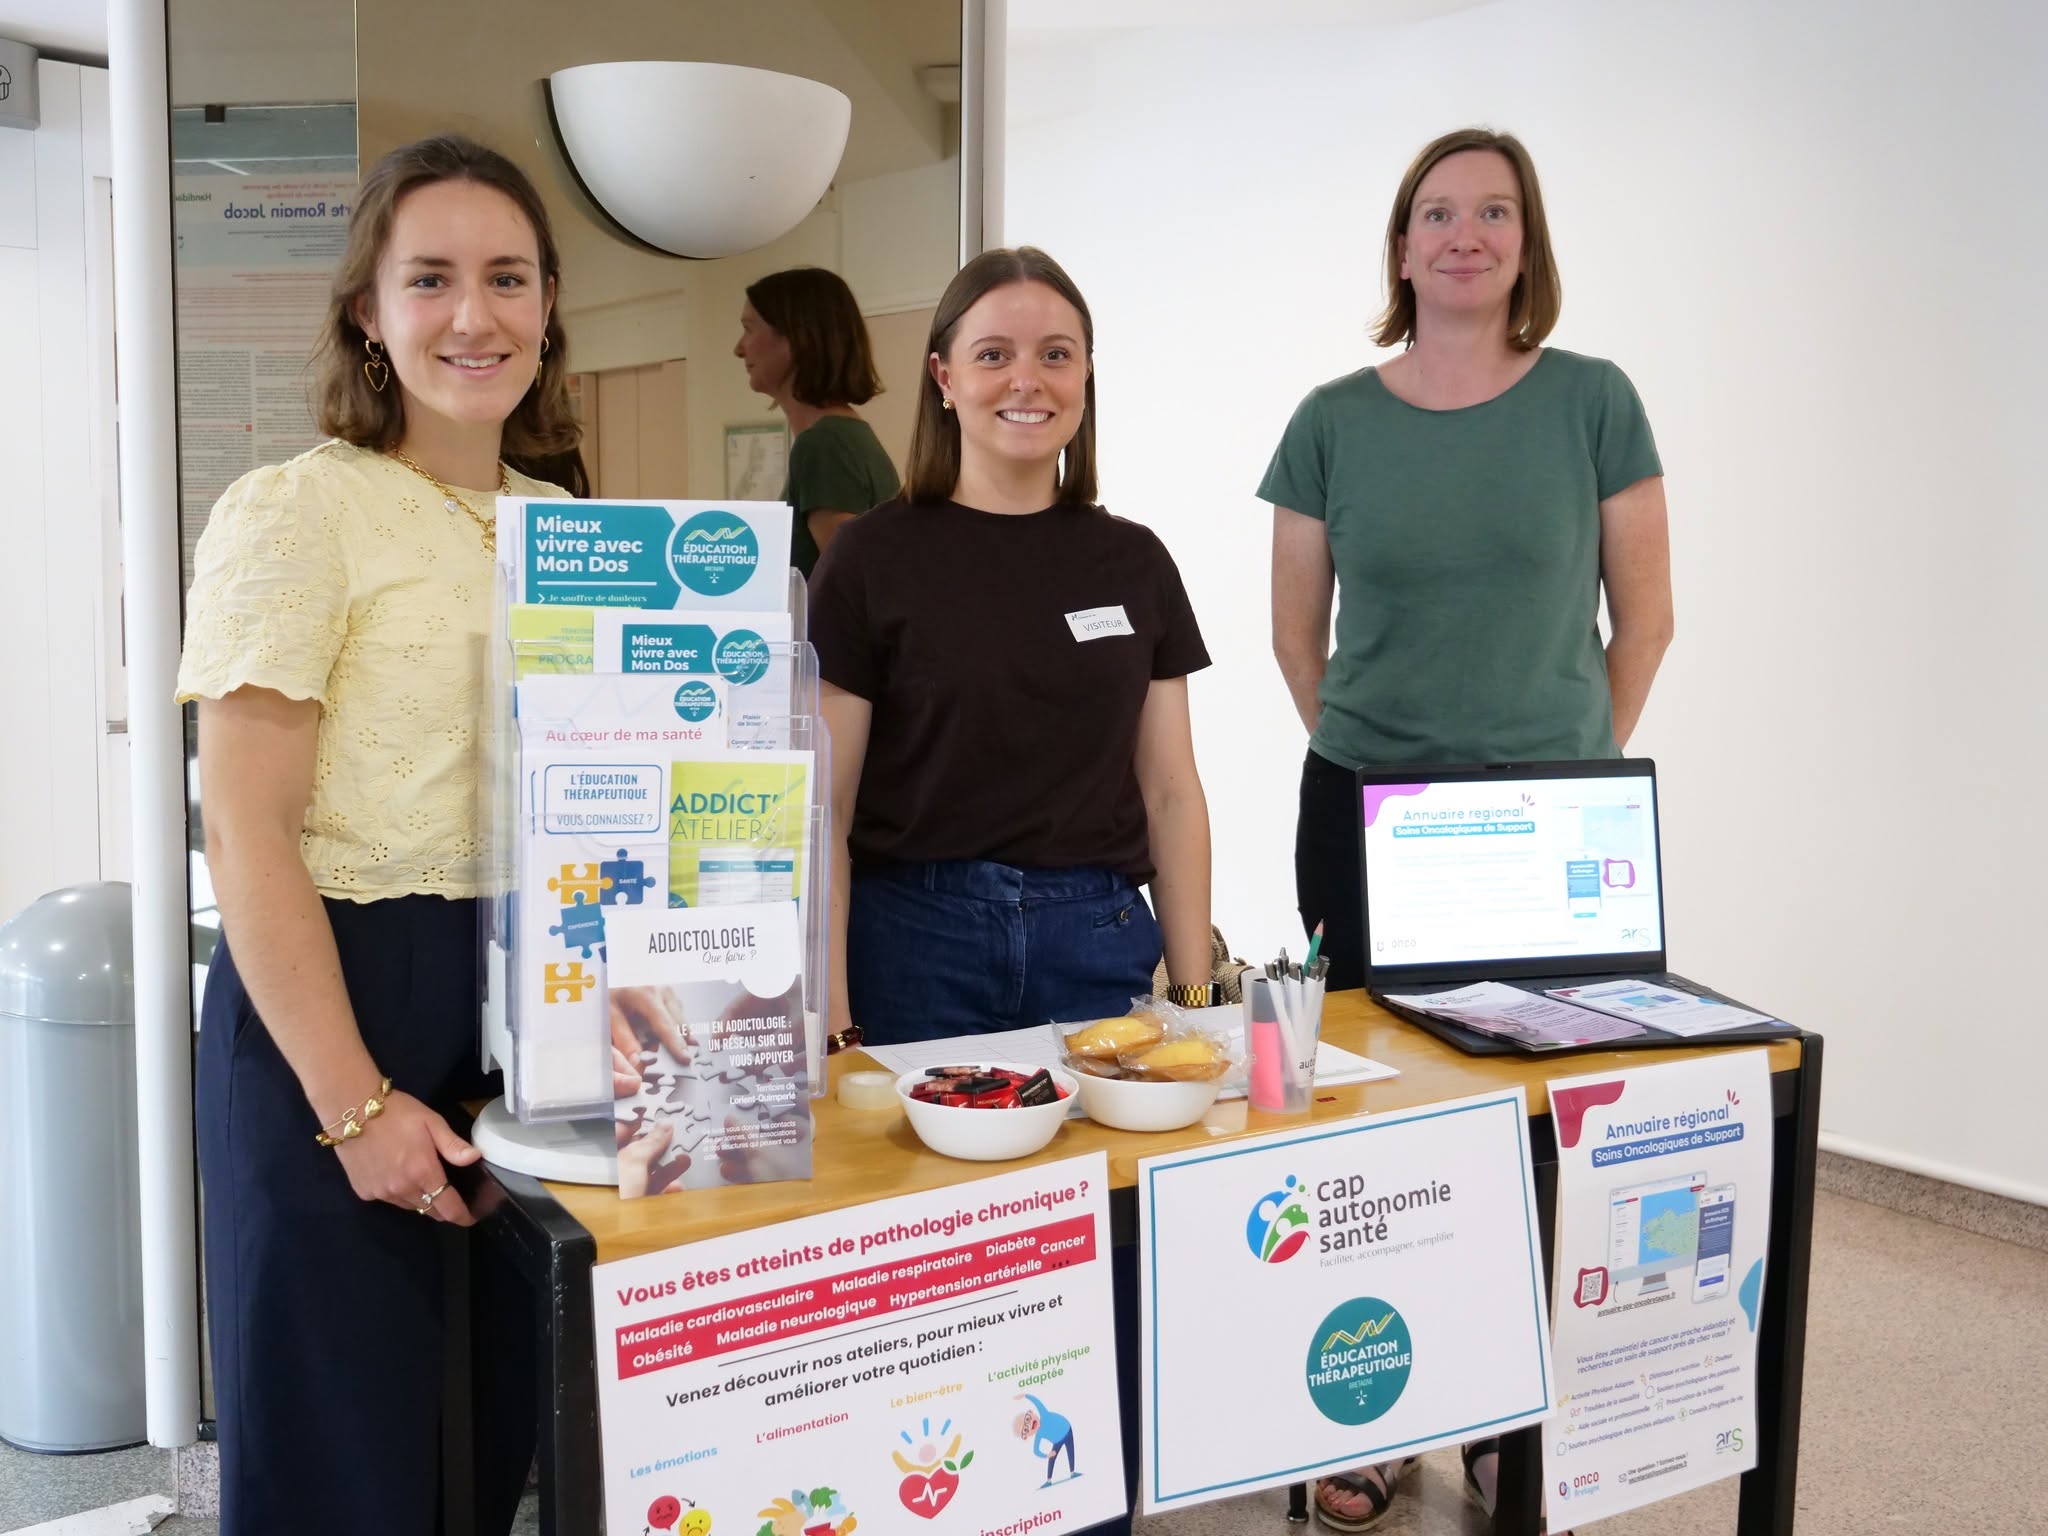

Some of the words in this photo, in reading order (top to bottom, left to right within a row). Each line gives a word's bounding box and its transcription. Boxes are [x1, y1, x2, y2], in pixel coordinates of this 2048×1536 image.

[536, 515, 602, 533] Mieux
[536, 534, 589, 553] vivre
[594, 539, 643, 553] avec
[683, 540, 747, 555] ÉDUCATION
[536, 556, 583, 572] Mon
[589, 556, 629, 573] Dos
[672, 553, 757, 565] THÉRAPEUTIQUE
[595, 594, 606, 602] de
[1082, 619, 1125, 632] VISITEUR
[632, 635, 672, 646] Mieux
[631, 647, 665, 658] vivre
[667, 649, 698, 659] avec
[632, 660, 660, 670] Mon
[664, 660, 689, 671] Dos
[546, 730, 566, 742] Au
[570, 731, 609, 742] cœur
[614, 728, 632, 741] de
[636, 732, 658, 741] ma
[662, 728, 703, 741] santé
[570, 771, 638, 786] L'ÉDUCATION
[564, 785, 648, 800] THÉRAPEUTIQUE
[670, 793, 778, 814] ADDICT'
[557, 814, 584, 826] VOUS
[586, 813, 644, 826] CONNAISSEZ
[646, 814, 653, 825] ?
[1403, 809, 1465, 821] Annuaire
[1469, 806, 1524, 821] régional
[670, 818, 776, 841] ATELIERS
[1396, 826, 1420, 836] Soins
[1422, 824, 1483, 836] Oncologiques
[1484, 823, 1495, 832] de
[1497, 822, 1533, 833] Support
[648, 926, 755, 954] ADDICTOLOGIE
[702, 951, 722, 964] Que
[725, 949, 746, 965] faire
[750, 950, 757, 961] ?
[677, 1024, 688, 1037] LE
[712, 1020, 723, 1034] EN
[726, 1015, 786, 1033] ADDICTOLOGIE
[708, 1038, 720, 1052] UN
[723, 1035, 755, 1051] RÉSEAU
[758, 1034, 776, 1047] SUR
[778, 1033, 793, 1045] QUI
[729, 1053, 753, 1067] VOUS
[755, 1050, 794, 1066] APPUYER
[786, 1082, 795, 1090] de
[1606, 1115, 1671, 1140] Annuaire
[1674, 1104, 1729, 1129] régional
[1595, 1147, 1623, 1163] Soins
[1624, 1138, 1690, 1158] Oncologiques
[1691, 1133, 1703, 1144] de
[1705, 1126, 1741, 1142] Support
[1317, 1174, 1364, 1202] cap
[1319, 1180, 1451, 1228] autonomie
[617, 1281, 677, 1307] Vous
[682, 1267, 731, 1291] êtes
[736, 1245, 823, 1279] atteints
[828, 1236, 855, 1257] de
[860, 1209, 974, 1254] pathologie
[978, 1185, 1076, 1223] chronique
[1079, 1180, 1089, 1197] ?
[1320, 1214, 1388, 1253] santé
[1320, 1253, 1355, 1268] Faciliter,
[1357, 1242, 1415, 1262] accompagner,
[1417, 1231, 1455, 1247] simplifier
[620, 1320, 684, 1347] Maladie
[687, 1289, 815, 1330] cardiovasculaire
[832, 1268, 889, 1295] Maladie
[892, 1251, 973, 1280] respiratoire
[986, 1235, 1036, 1257] Diabète
[1040, 1233, 1086, 1255] Cancer
[632, 1340, 693, 1368] Obésité
[716, 1319, 778, 1346] Maladie
[780, 1296, 877, 1330] neurologique
[889, 1273, 982, 1308] Hypertension
[984, 1258, 1043, 1284] artérielle
[665, 1384, 721, 1408] Venez
[723, 1360, 809, 1393] découvrir
[812, 1353, 843, 1372] nos
[846, 1335, 913, 1363] ateliers,
[916, 1324, 954, 1348] pour
[957, 1309, 1005, 1335] mieux
[1008, 1300, 1046, 1320] vivre
[1048, 1293, 1064, 1310] et
[1320, 1339, 1398, 1369] ÉDUCATION
[1577, 1355, 1593, 1364] Vous
[1640, 1340, 1648, 1348] de
[1649, 1336, 1670, 1346] cancer
[1577, 1359, 1613, 1375] recherchez
[1624, 1353, 1638, 1362] soin
[1639, 1350, 1647, 1358] de
[1648, 1343, 1672, 1356] support
[1687, 1337, 1695, 1345] de
[1696, 1334, 1710, 1343] chez
[1712, 1330, 1725, 1338] vous
[764, 1374, 849, 1407] améliorer
[851, 1362, 896, 1384] votre
[899, 1341, 976, 1375] quotidien
[987, 1358, 1040, 1383] L'activité
[1041, 1344, 1091, 1372] physique
[1309, 1353, 1410, 1387] THÉRAPEUTIQUE
[1018, 1367, 1065, 1389] adaptée
[890, 1396, 904, 1409] Le
[906, 1381, 963, 1406] bien-être
[756, 1411, 849, 1444] L'alimentation
[629, 1463, 652, 1480] Les
[654, 1446, 718, 1473] émotions
[1573, 1471, 1600, 1488] onco
[980, 1507, 1062, 1536] inscription
